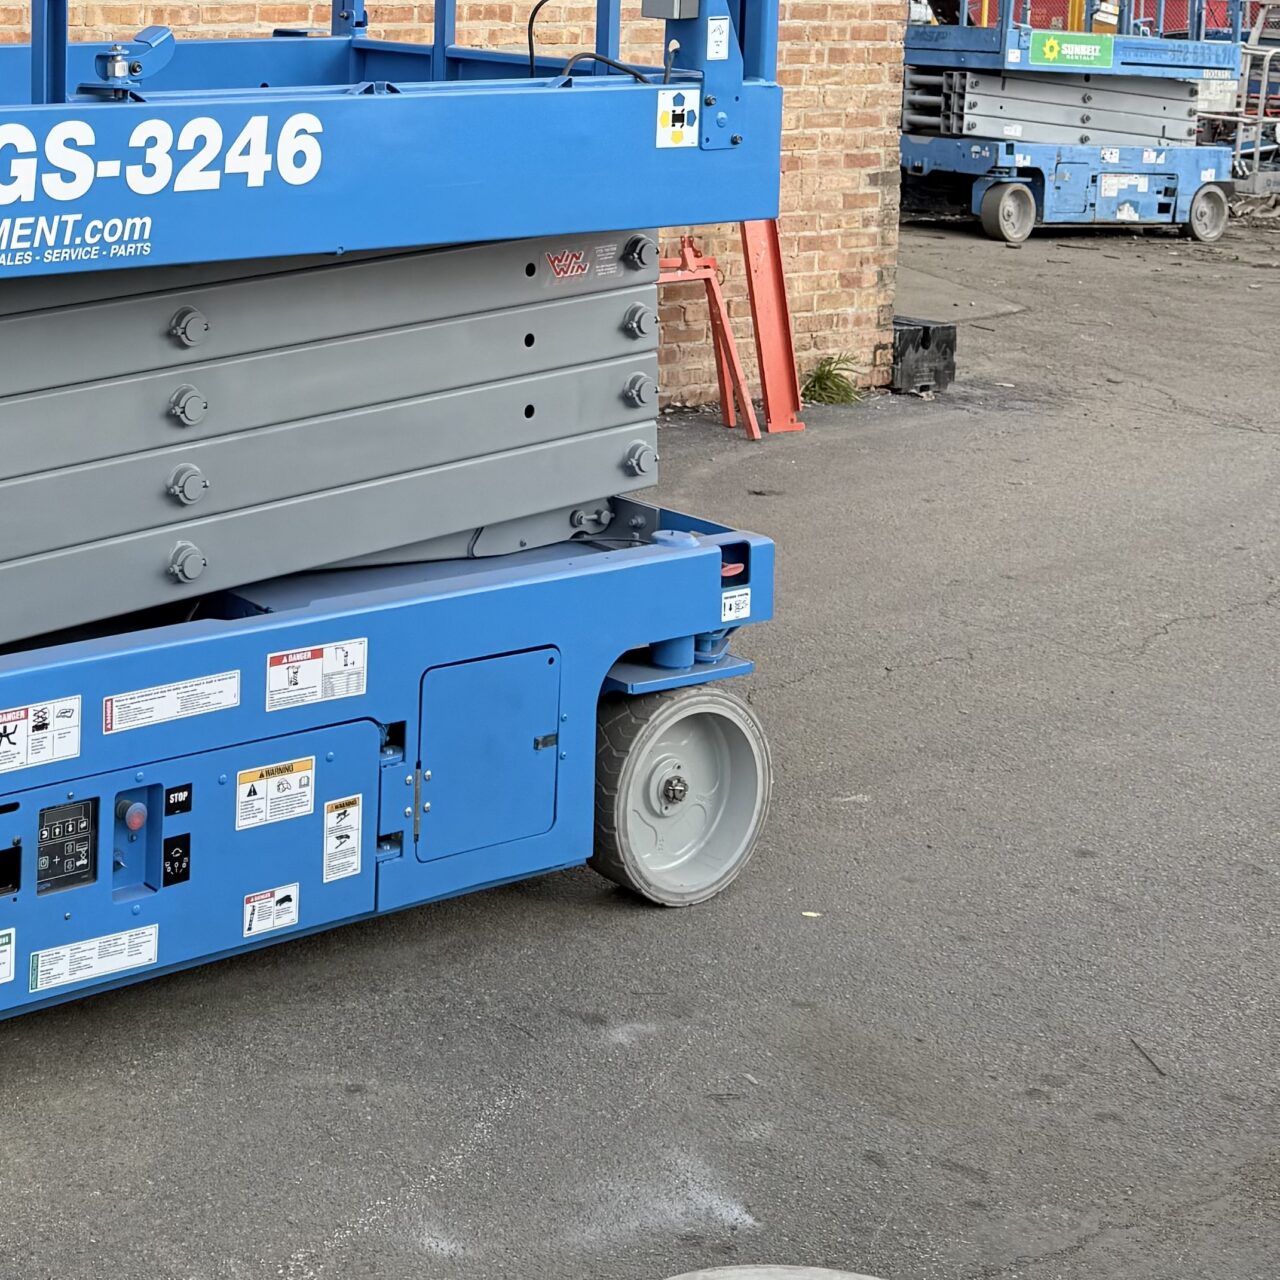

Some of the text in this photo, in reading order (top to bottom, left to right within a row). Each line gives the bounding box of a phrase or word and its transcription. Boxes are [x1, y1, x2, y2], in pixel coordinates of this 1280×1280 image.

[43, 246, 100, 263] SERVICE
[109, 242, 151, 257] PARTS
[552, 263, 590, 277] WIN
[265, 763, 294, 777] WARNING
[170, 791, 188, 804] STOP
